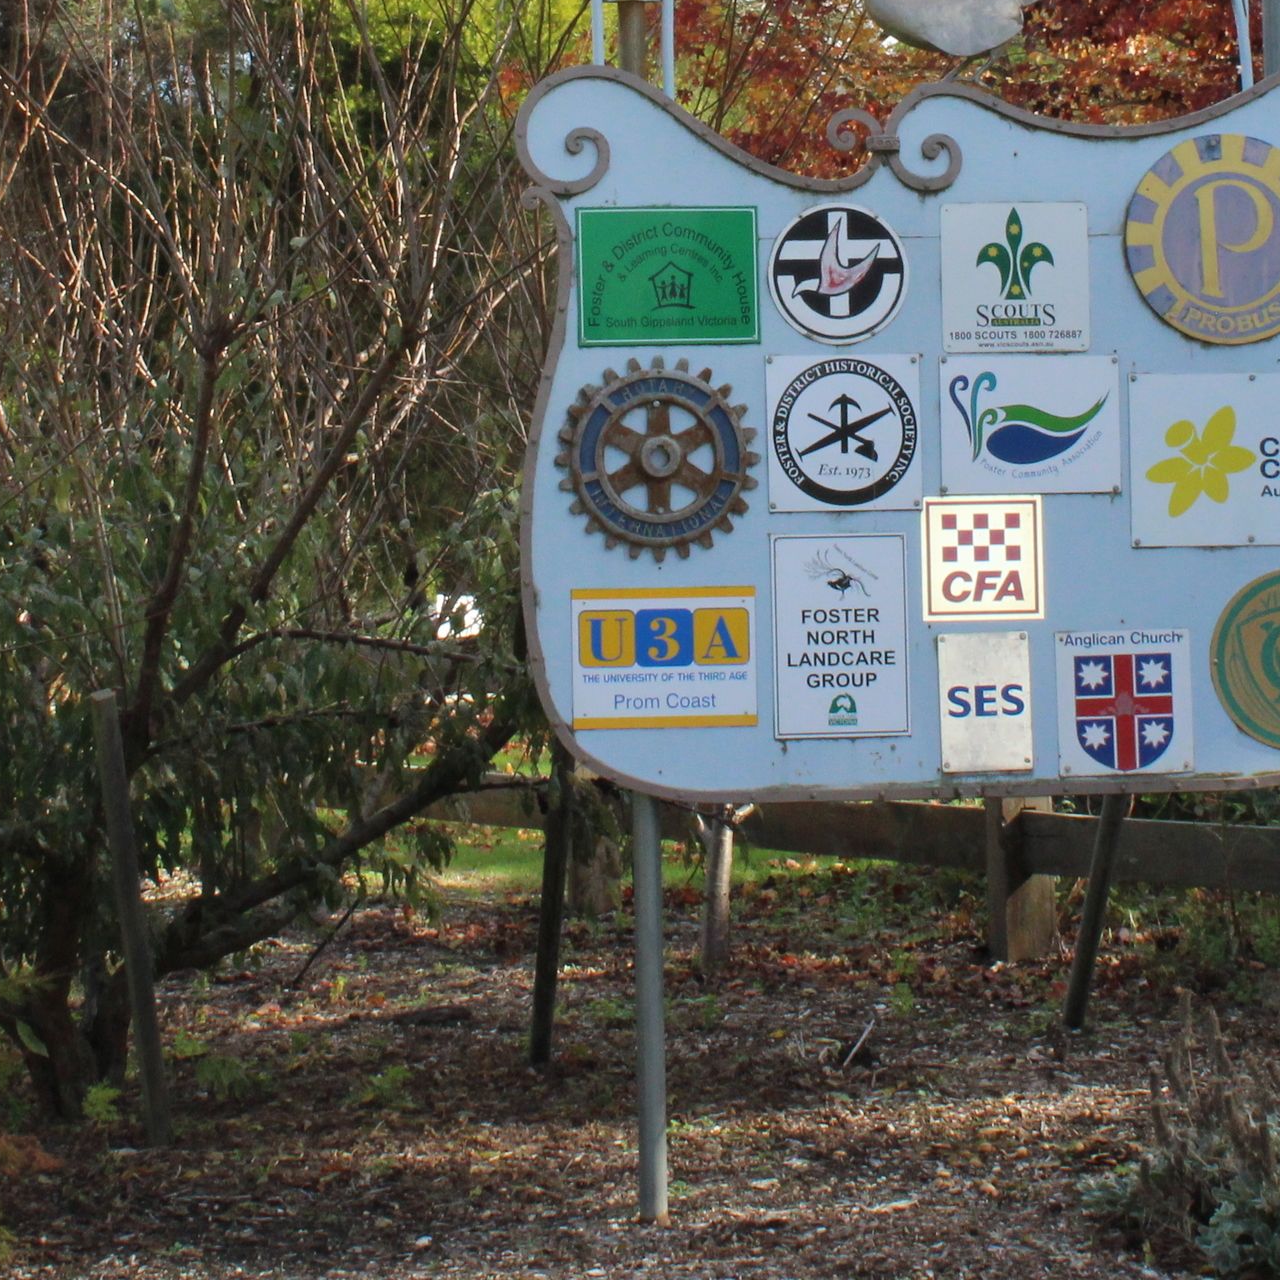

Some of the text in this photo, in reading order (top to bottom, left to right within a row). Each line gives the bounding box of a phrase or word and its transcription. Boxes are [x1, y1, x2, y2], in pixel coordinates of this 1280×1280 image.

[625, 245, 667, 272] Learning
[671, 244, 709, 267] Centres
[588, 222, 751, 327] Foster & District Community House
[606, 316, 737, 329] South Gippsland Victoria
[976, 304, 1056, 327] SCOUTS
[950, 330, 1082, 340] 1800 SCOUTS 1800 726887
[775, 360, 915, 485] FOSTER & DISTRICT HISTORICAL SOCIETY INC.
[979, 429, 1103, 479] Foster Community Association
[818, 464, 871, 479] Est. 1973
[942, 570, 1024, 603] CFA
[801, 608, 880, 624] FOSTER
[807, 629, 875, 645] NORTH
[1064, 631, 1181, 648] Anglican Church
[787, 650, 896, 667] LANDCARE
[583, 671, 748, 683] THE UNIVERSITY OF THE THIRD AGE
[806, 673, 877, 688] GROUP
[613, 693, 716, 709] Prom Coast
[947, 684, 1025, 718] SES
